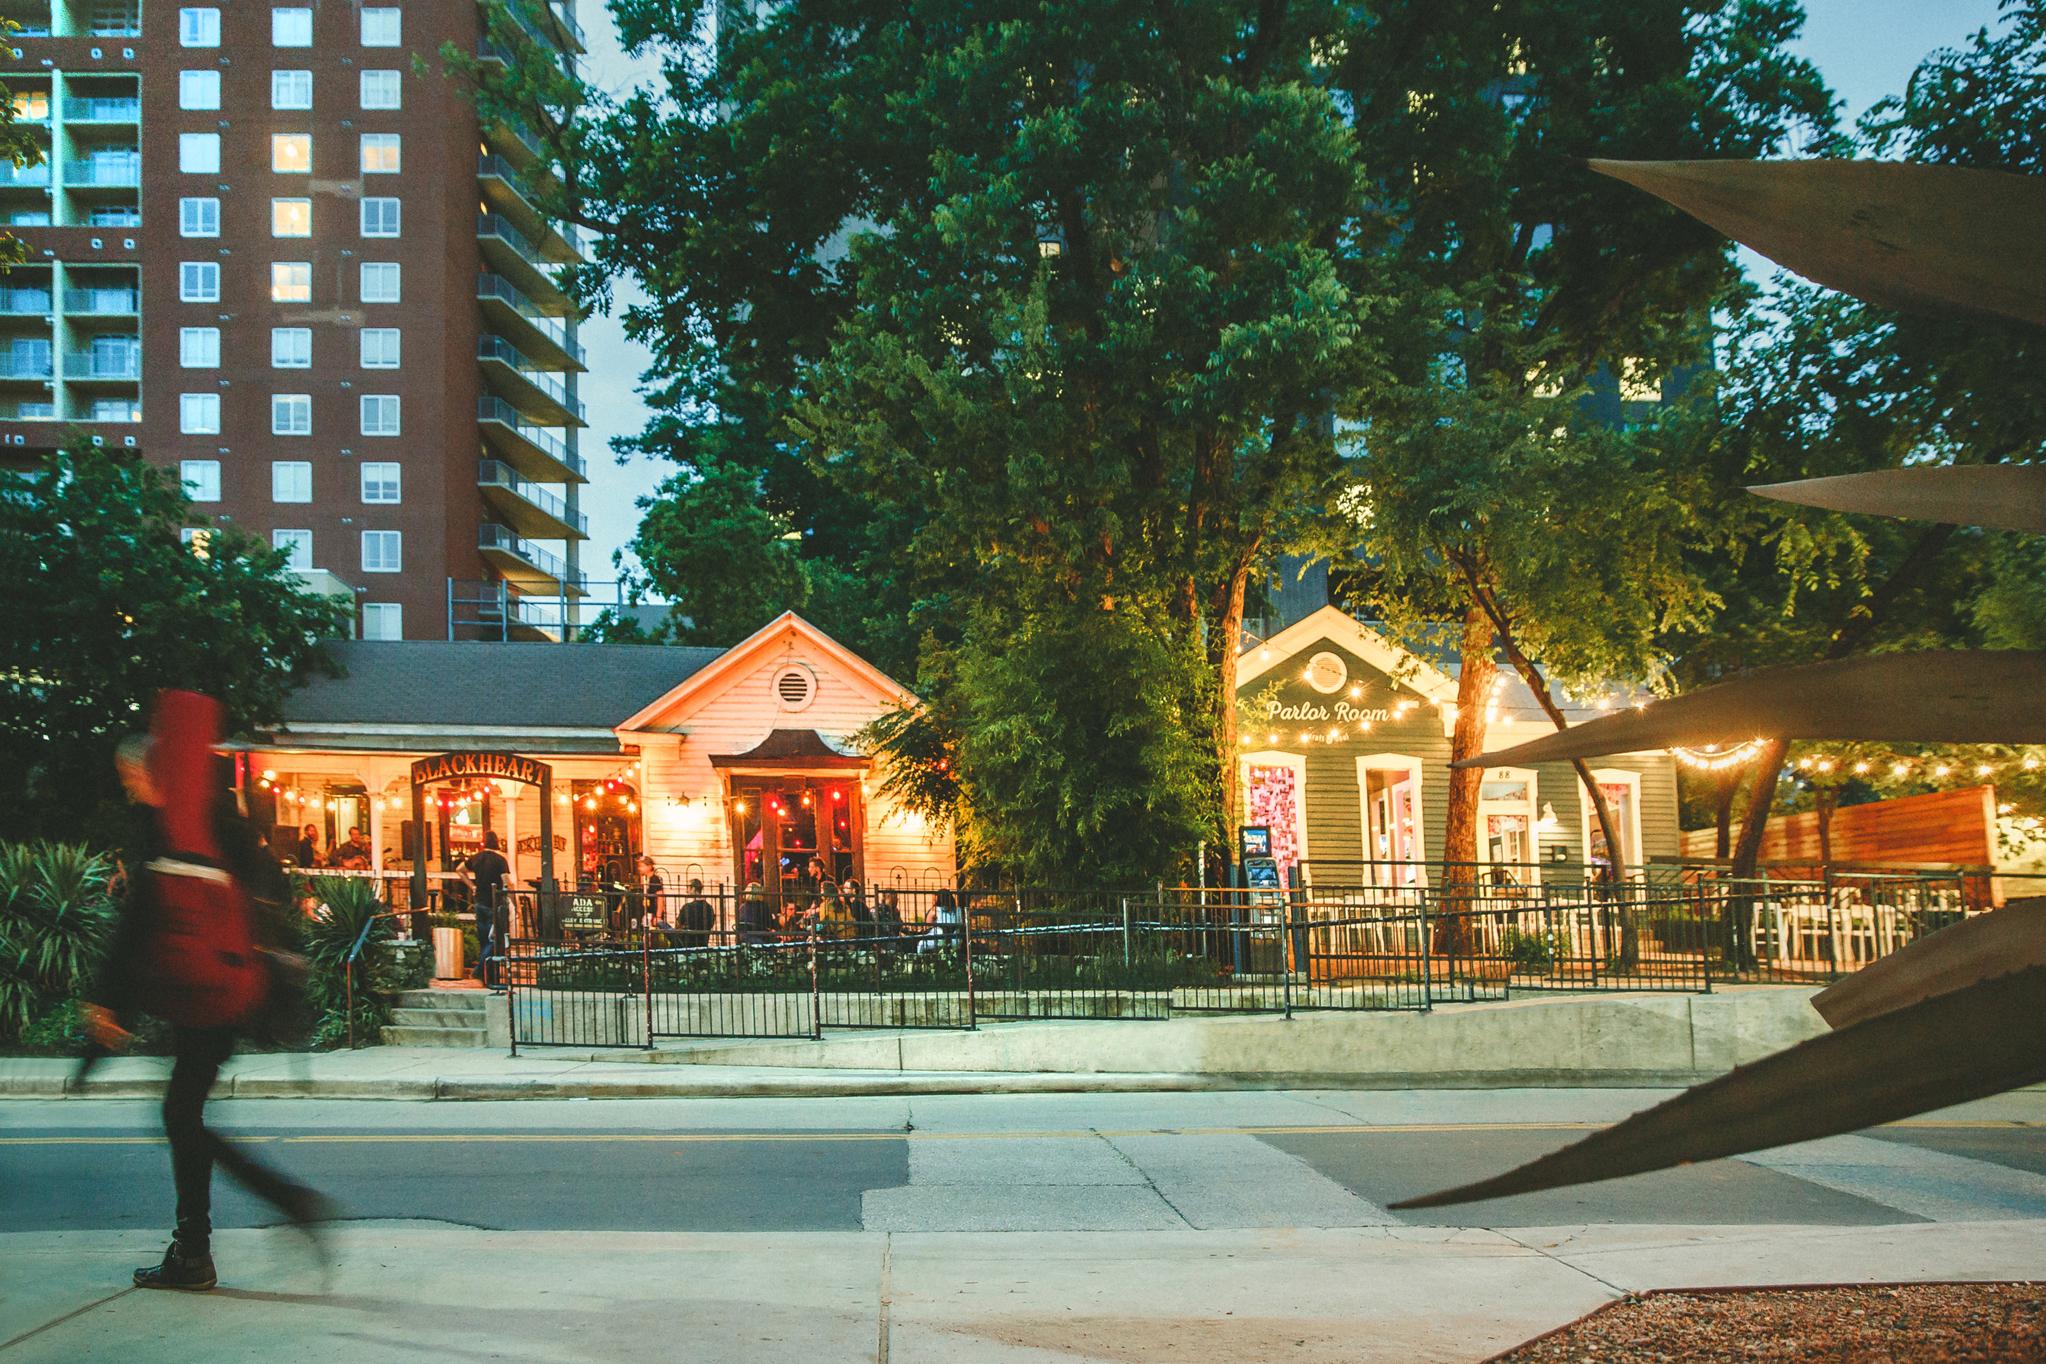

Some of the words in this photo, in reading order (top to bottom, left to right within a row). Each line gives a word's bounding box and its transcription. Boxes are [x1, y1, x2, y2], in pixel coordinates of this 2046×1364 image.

[1266, 700, 1330, 721] Parlor
[1334, 701, 1389, 722] Room
[414, 753, 547, 785] BLACKHEART
[572, 898, 593, 906] ADA
